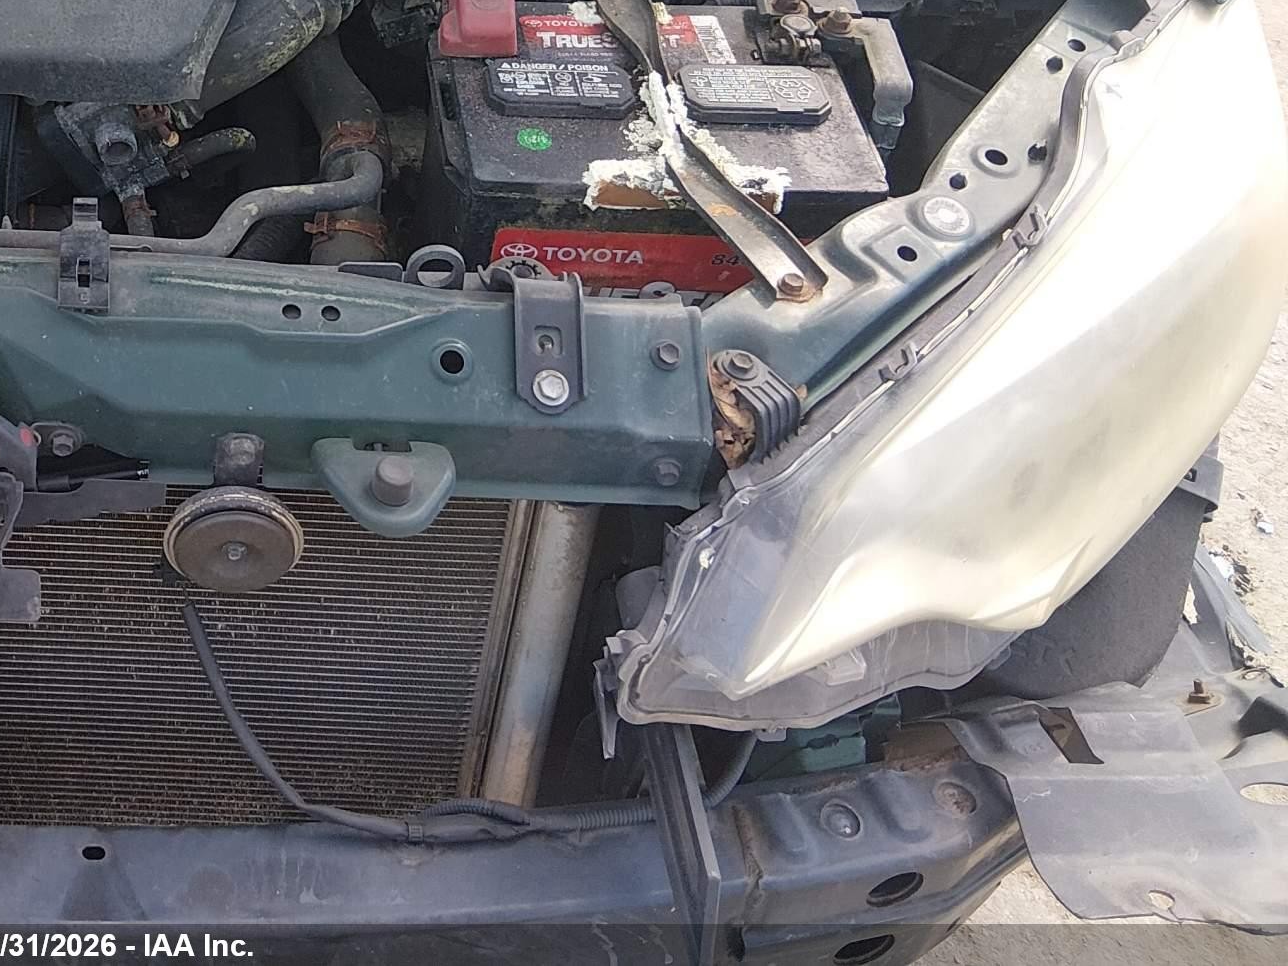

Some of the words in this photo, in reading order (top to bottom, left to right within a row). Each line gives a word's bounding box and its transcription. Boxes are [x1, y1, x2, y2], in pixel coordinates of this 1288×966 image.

[512, 62, 557, 71] DANGER
[567, 63, 609, 72] POISON
[543, 246, 644, 265] TOYOTA
